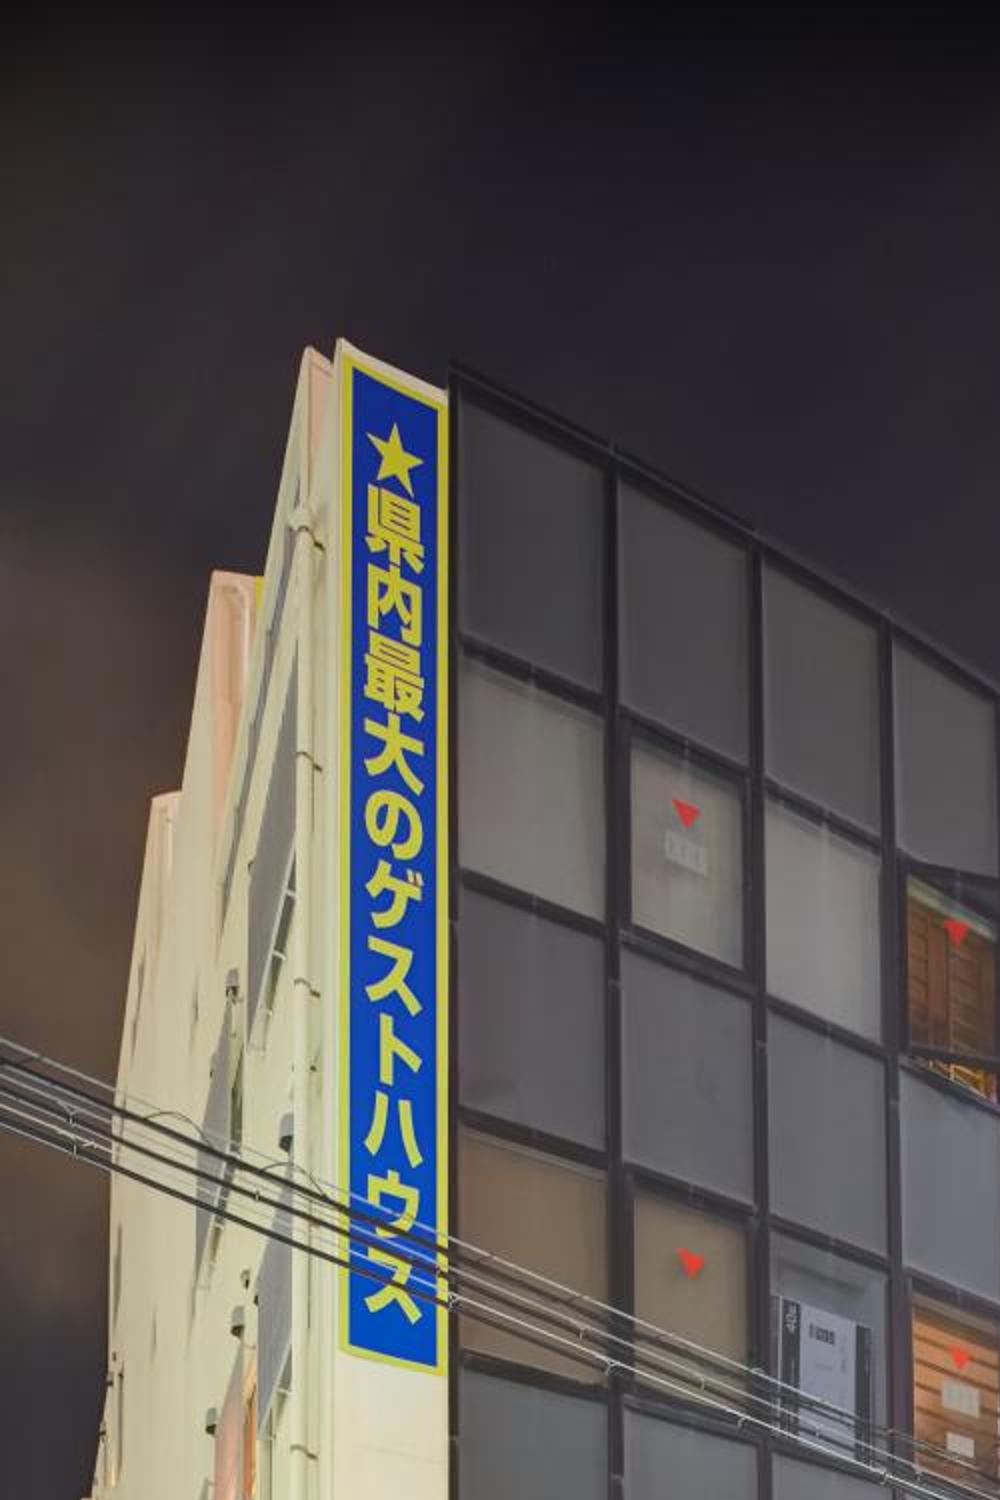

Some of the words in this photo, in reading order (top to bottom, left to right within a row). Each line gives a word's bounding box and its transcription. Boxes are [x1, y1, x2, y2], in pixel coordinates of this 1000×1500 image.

[364, 484, 425, 1326] 県内最大のゲストハウス
